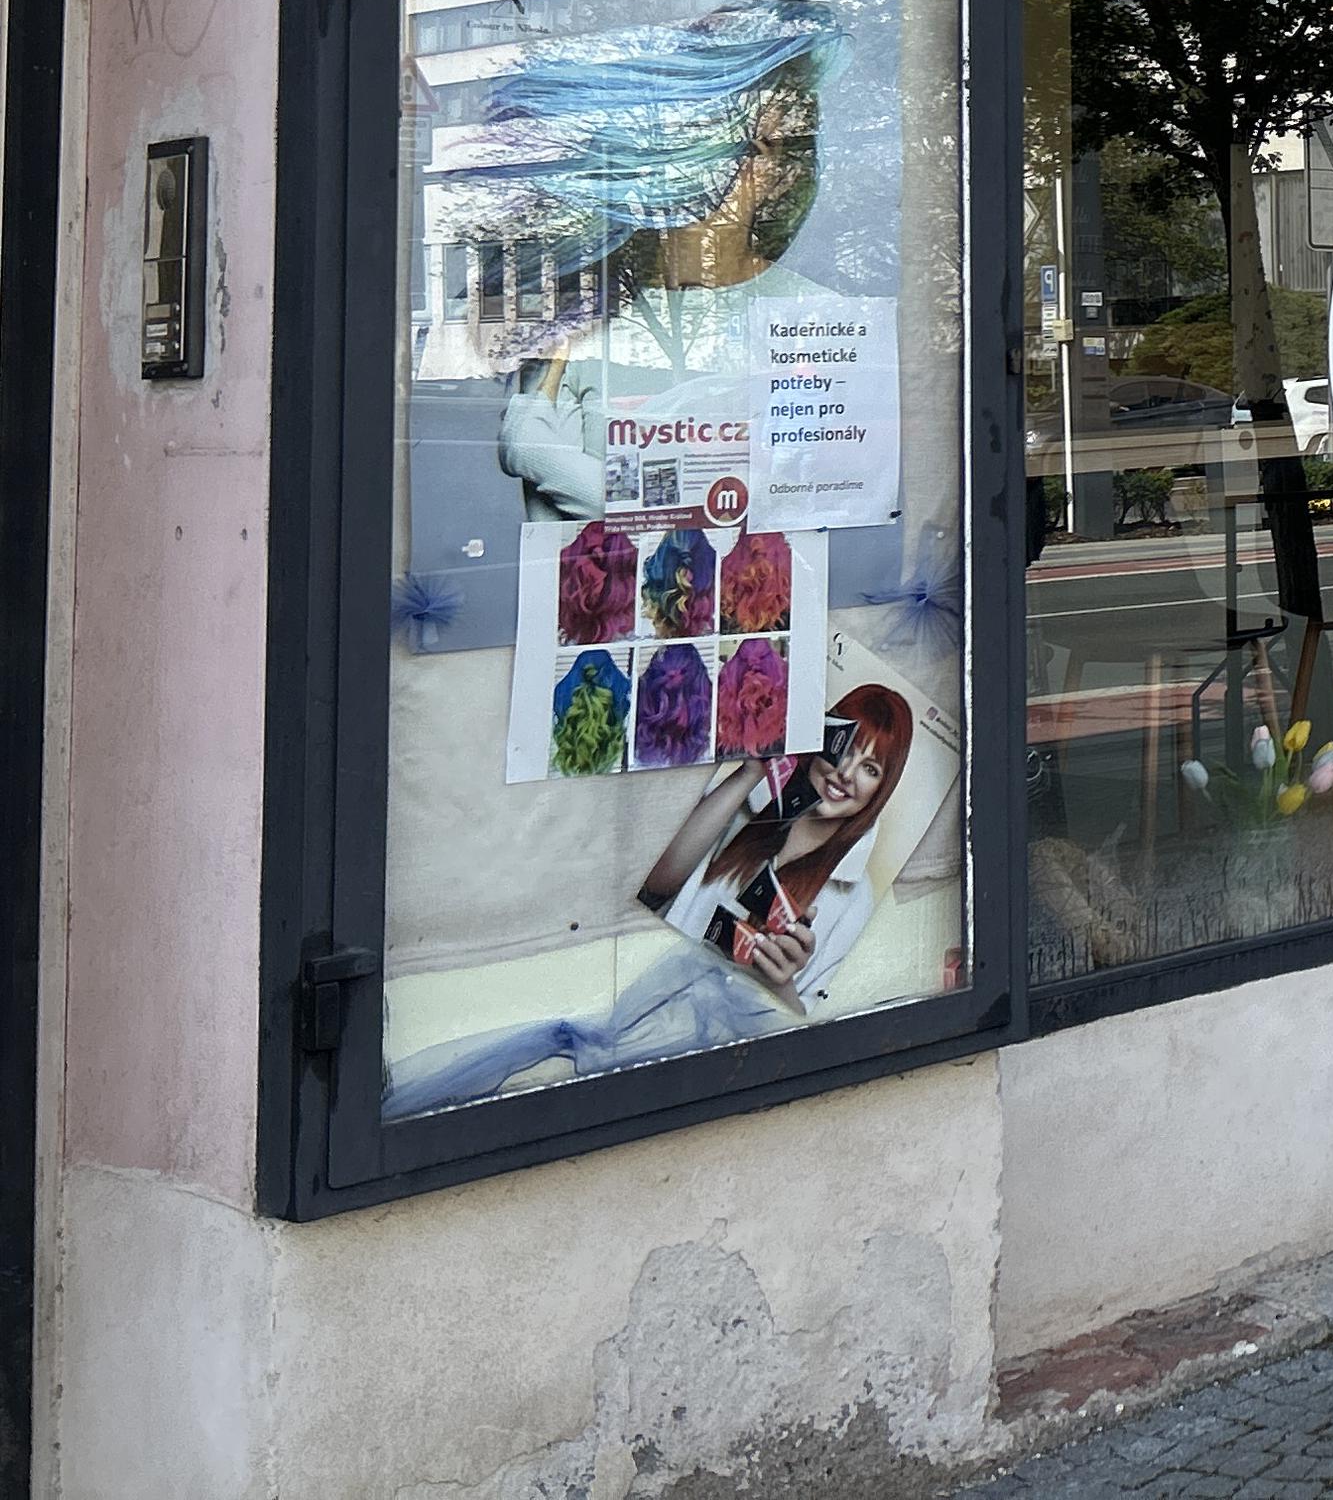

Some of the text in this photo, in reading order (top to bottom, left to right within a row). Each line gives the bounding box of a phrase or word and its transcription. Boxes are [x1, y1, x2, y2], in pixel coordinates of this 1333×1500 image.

[770, 321, 867, 338] Kadeřnické a
[770, 348, 857, 364] kosmetické
[771, 374, 832, 393] potřeby
[771, 402, 845, 420] nejen pro
[771, 424, 867, 446] profesionály
